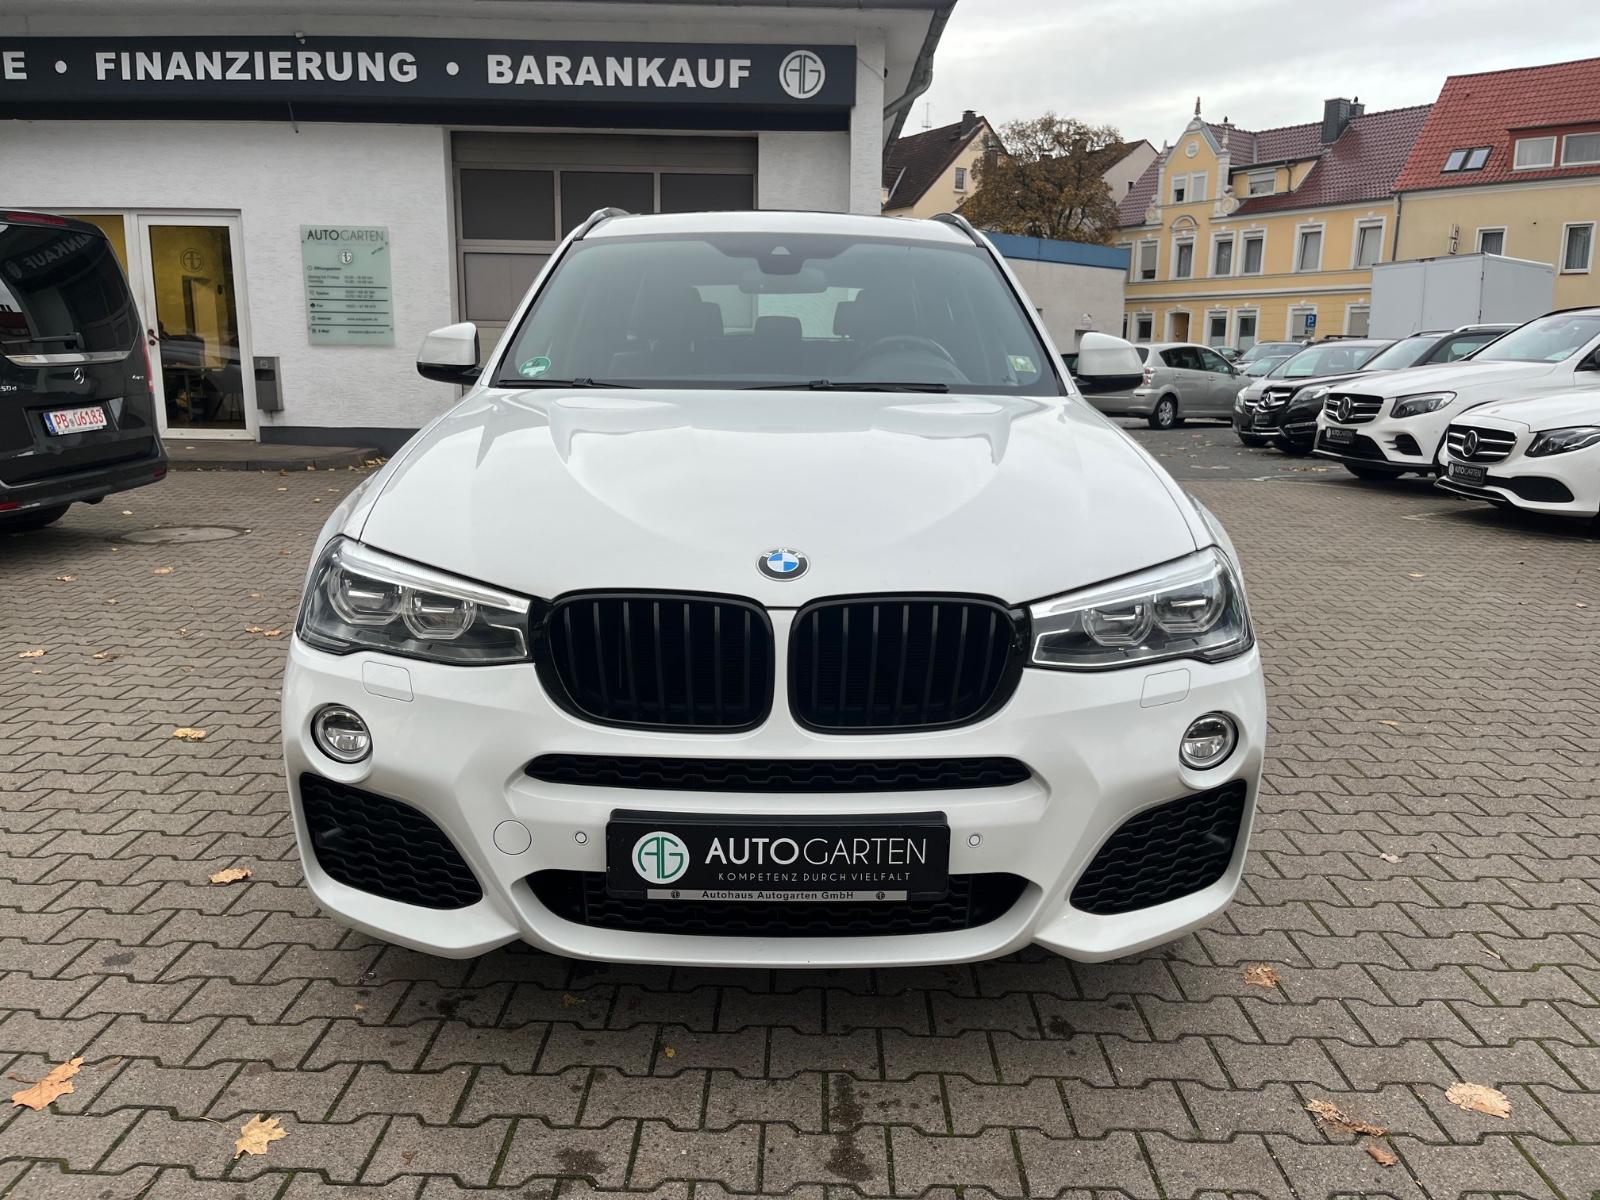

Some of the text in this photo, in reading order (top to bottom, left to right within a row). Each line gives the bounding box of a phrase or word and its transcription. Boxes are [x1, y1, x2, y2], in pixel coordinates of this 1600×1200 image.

[95, 51, 418, 83] FINANZIERUNG
[486, 54, 752, 89] BARANKAUF
[307, 229, 384, 241] AUTOGARTEN
[1307, 315, 1315, 327] P
[704, 837, 927, 866] AUTOGARTEN
[718, 872, 911, 882] KOMPETENZ DURCH VIELFALT
[701, 890, 854, 901] Autohaus Autogarten GmbH
